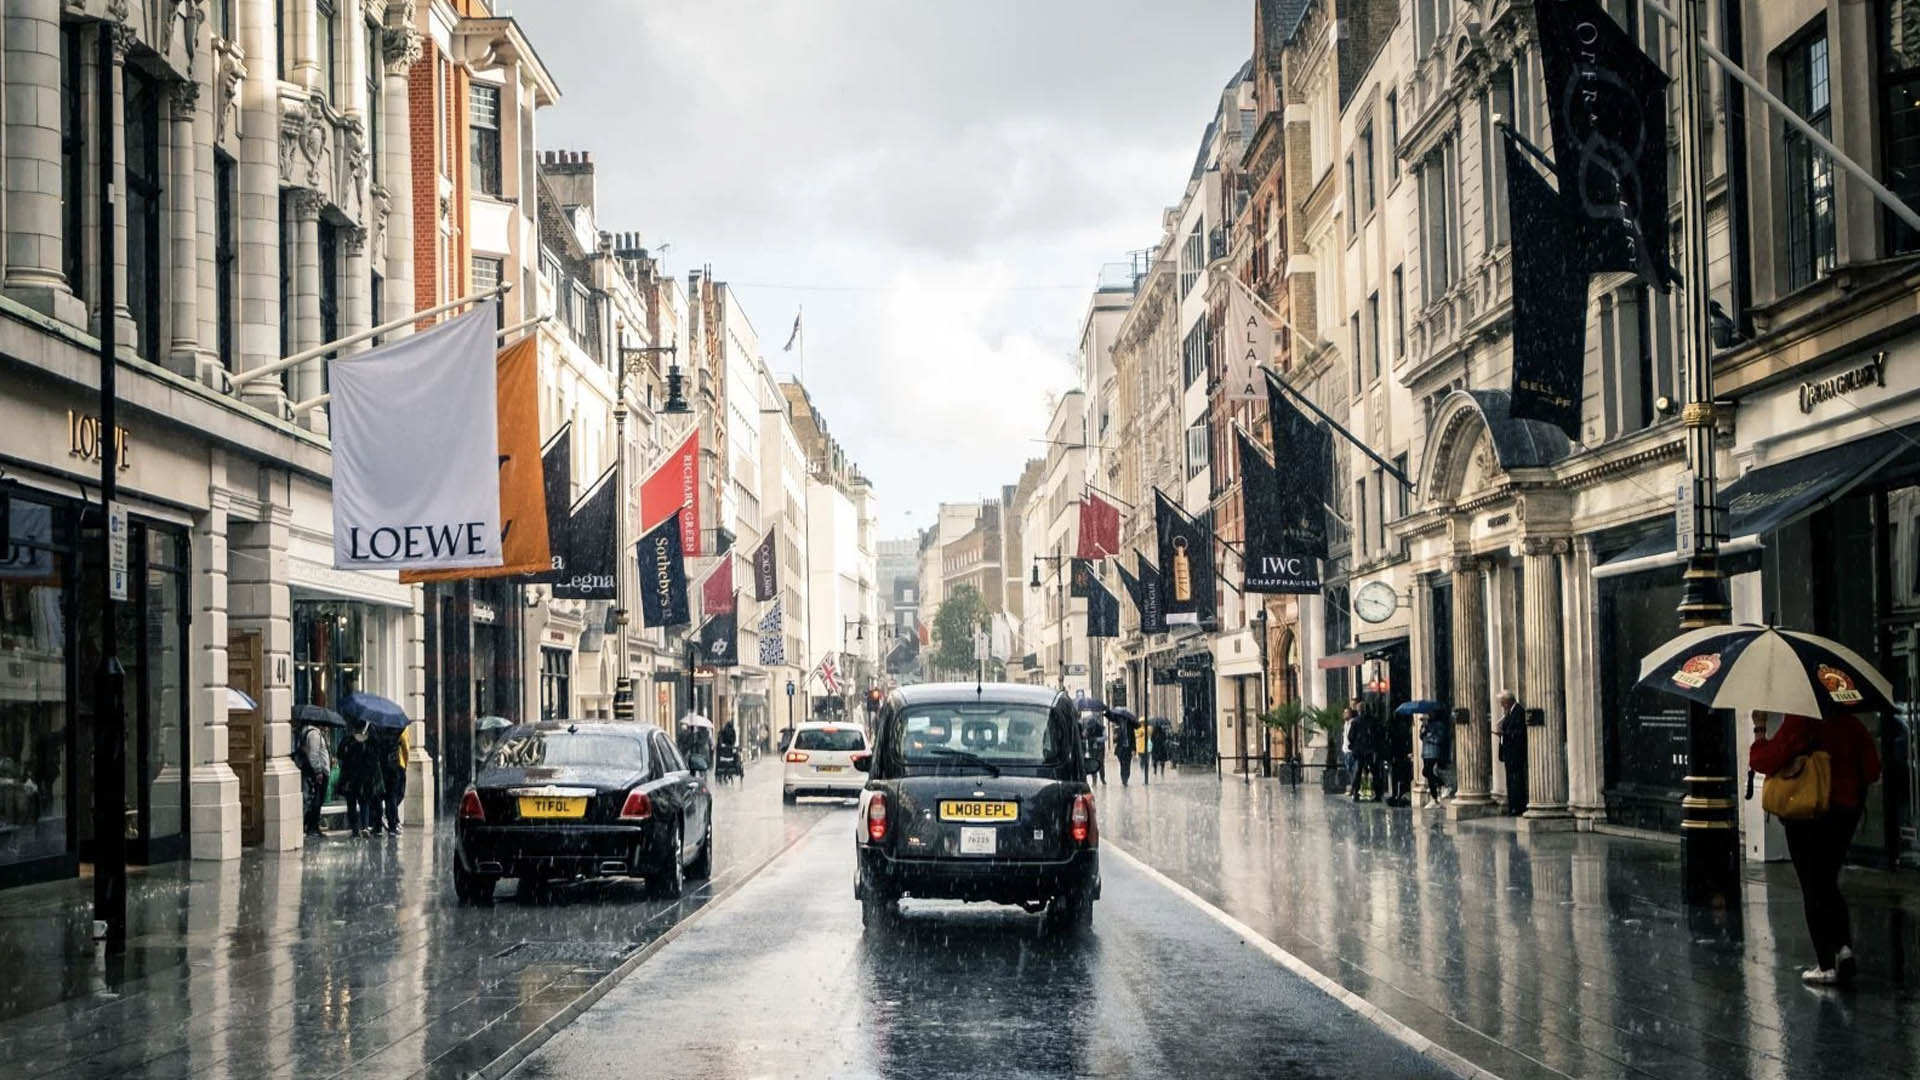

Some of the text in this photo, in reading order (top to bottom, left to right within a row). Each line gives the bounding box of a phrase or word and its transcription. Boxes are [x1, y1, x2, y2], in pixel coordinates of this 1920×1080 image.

[68, 409, 130, 469] LOEE
[684, 454, 695, 552] RICHARD GREEN
[350, 521, 486, 560] LOEWE
[1262, 557, 1301, 576] IWC
[556, 573, 615, 592] egna
[1247, 578, 1318, 587] SCHAFFHAUSEN
[946, 803, 1011, 816] LM08 EPL
